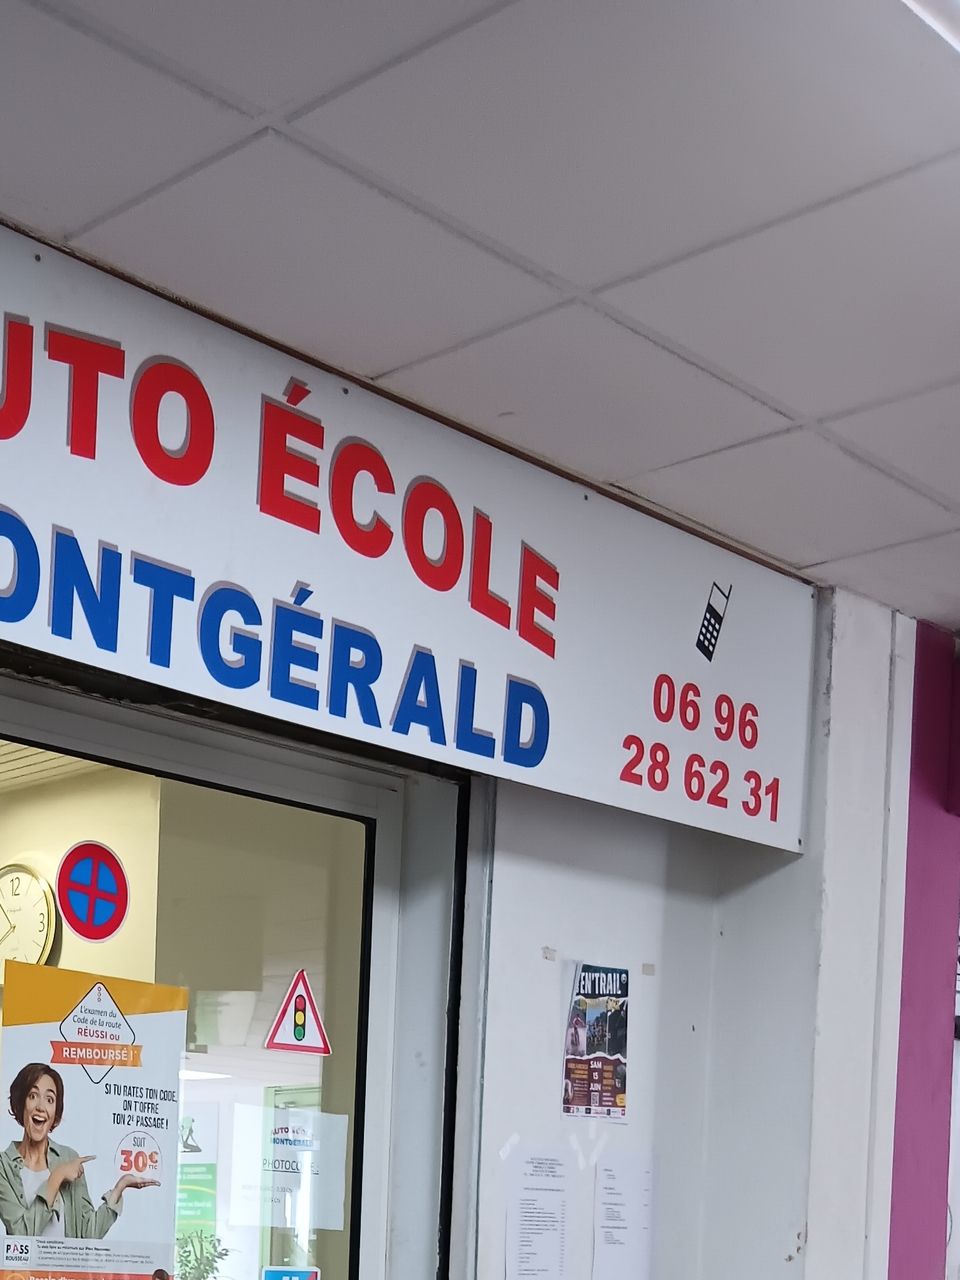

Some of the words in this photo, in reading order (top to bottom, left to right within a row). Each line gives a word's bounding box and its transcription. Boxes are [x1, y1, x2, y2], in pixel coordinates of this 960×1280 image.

[257, 376, 559, 659] ÉCOLE
[653, 674, 700, 730] 06
[714, 694, 759, 749] 96
[620, 735, 670, 791] 28
[684, 753, 730, 809] 62
[742, 770, 780, 822] 31
[10, 877, 21, 896] 12
[38, 912, 46, 932] 3
[80, 1005, 107, 1017] L'examen
[109, 1010, 117, 1018] du
[73, 1015, 88, 1024] Code
[90, 1016, 97, 1026] de
[98, 1018, 104, 1026] la
[77, 1026, 108, 1039] RÉUSSI
[63, 1047, 128, 1060] REMBOURSÉ
[104, 1083, 111, 1095] SI
[113, 1084, 121, 1096] TU
[123, 1085, 143, 1099] RATES
[145, 1087, 158, 1101] TON
[123, 1100, 132, 1111] ON
[112, 1113, 126, 1125] TON
[135, 1116, 164, 1129] PASSAGE
[133, 1136, 146, 1147] SOIT
[6, 1244, 29, 1255] PASS
